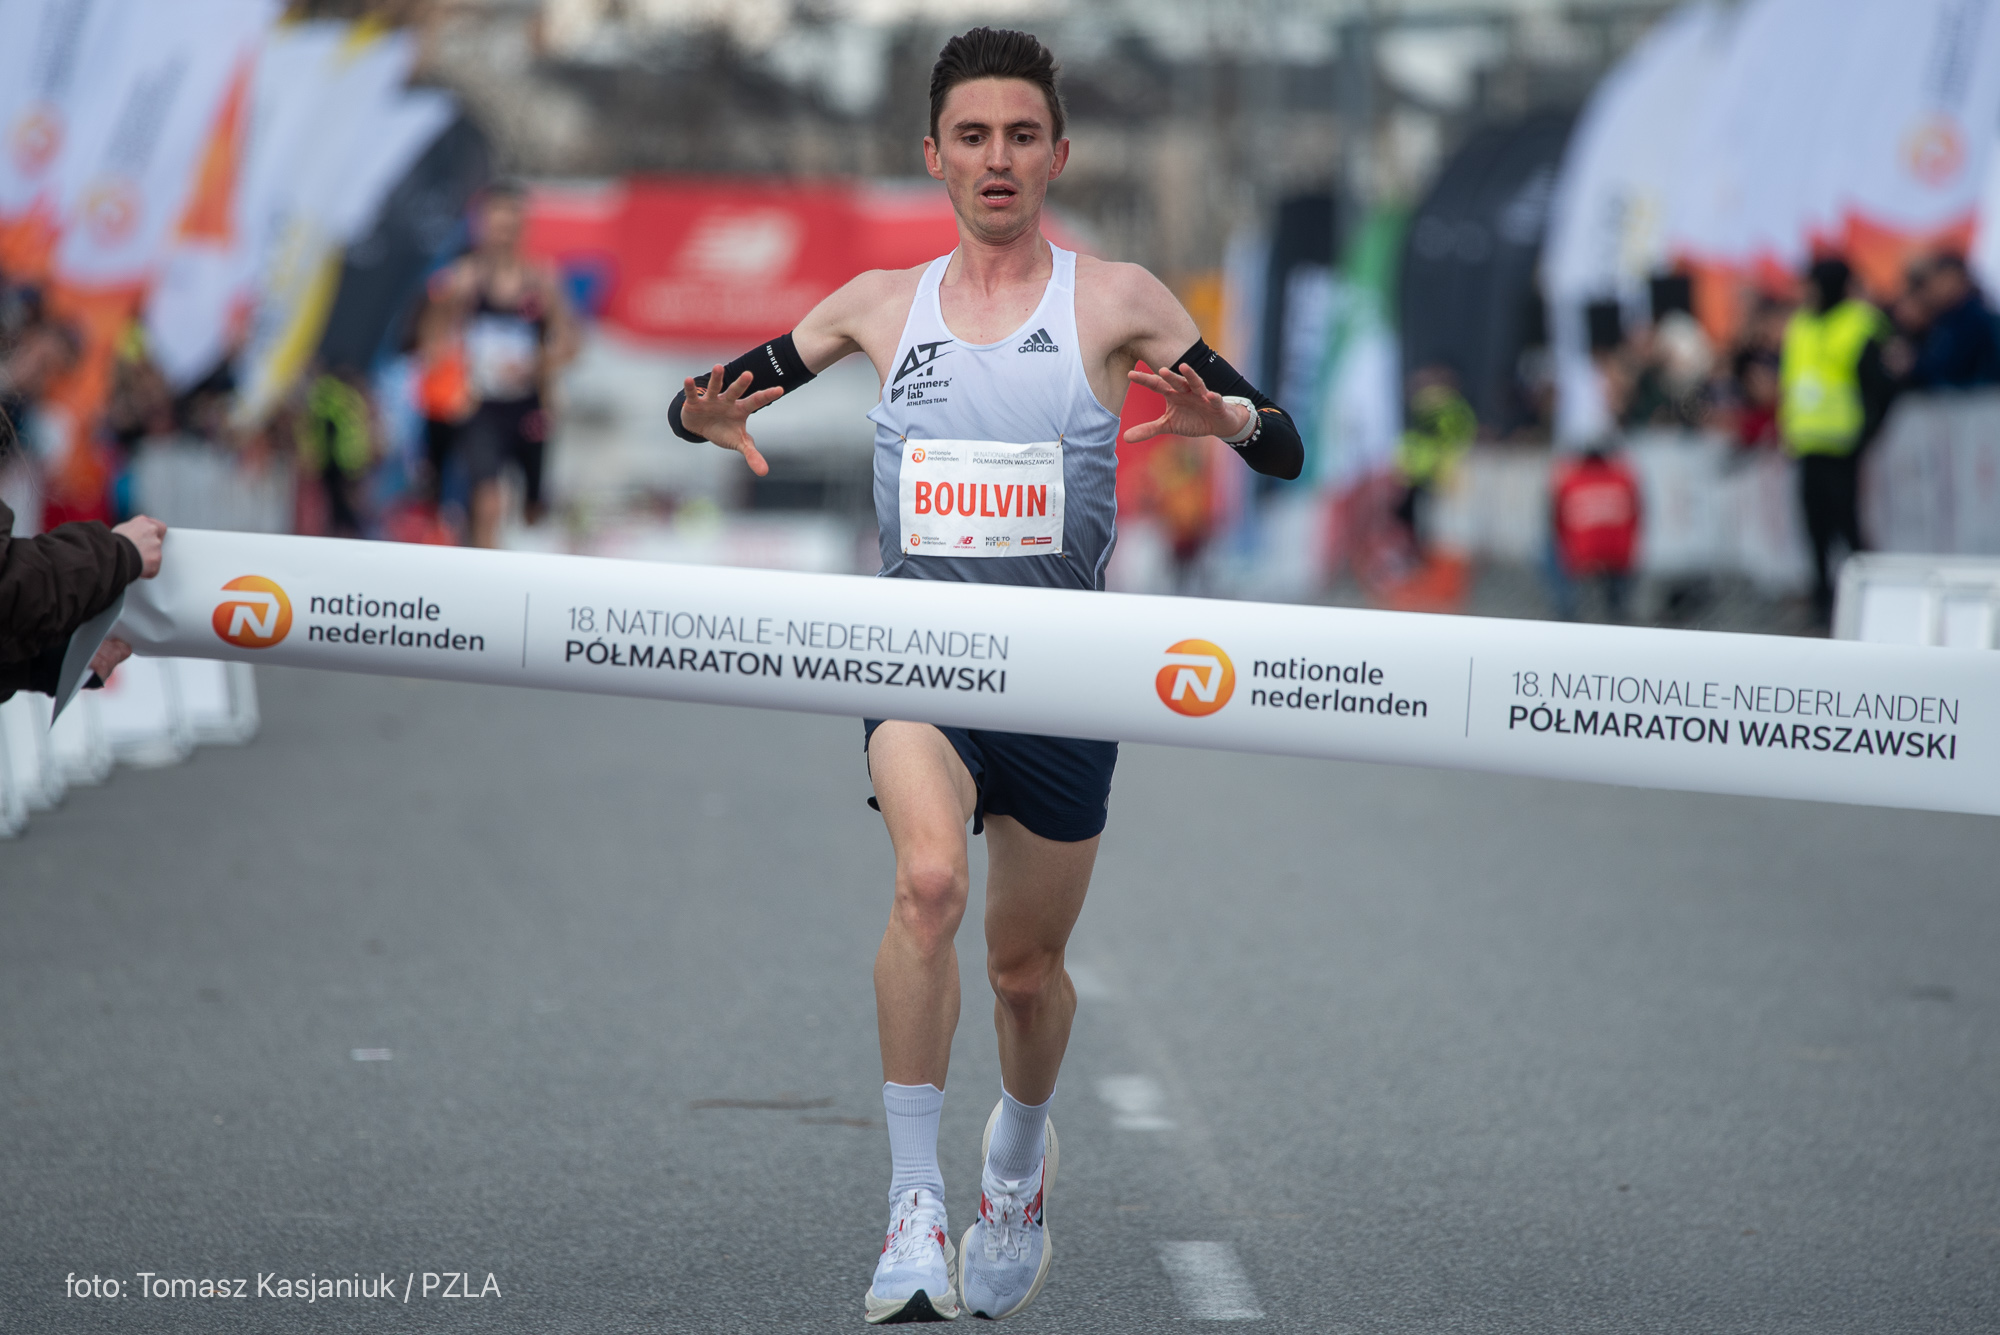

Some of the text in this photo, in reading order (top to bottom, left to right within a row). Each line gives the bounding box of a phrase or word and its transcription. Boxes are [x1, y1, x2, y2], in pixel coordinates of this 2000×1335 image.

[1018, 342, 1059, 353] adidas
[906, 399, 933, 407] ATHLETICS
[907, 389, 924, 400] lab
[915, 481, 1047, 517] BOULVIN
[310, 593, 441, 621] nationale
[308, 622, 485, 651] nederlanden
[567, 606, 1009, 660] 18. NATIONALE-NEDERLANDEN
[565, 636, 1007, 693] PÓŁMARATON WARSZAWSKI
[1253, 657, 1384, 685] nationale
[1251, 687, 1427, 717] nederlanden
[1511, 671, 1960, 725] 18. NATIONALE-NEDERLANDEN
[1508, 702, 1957, 760] PÓŁMARATON WARSZAWSKI
